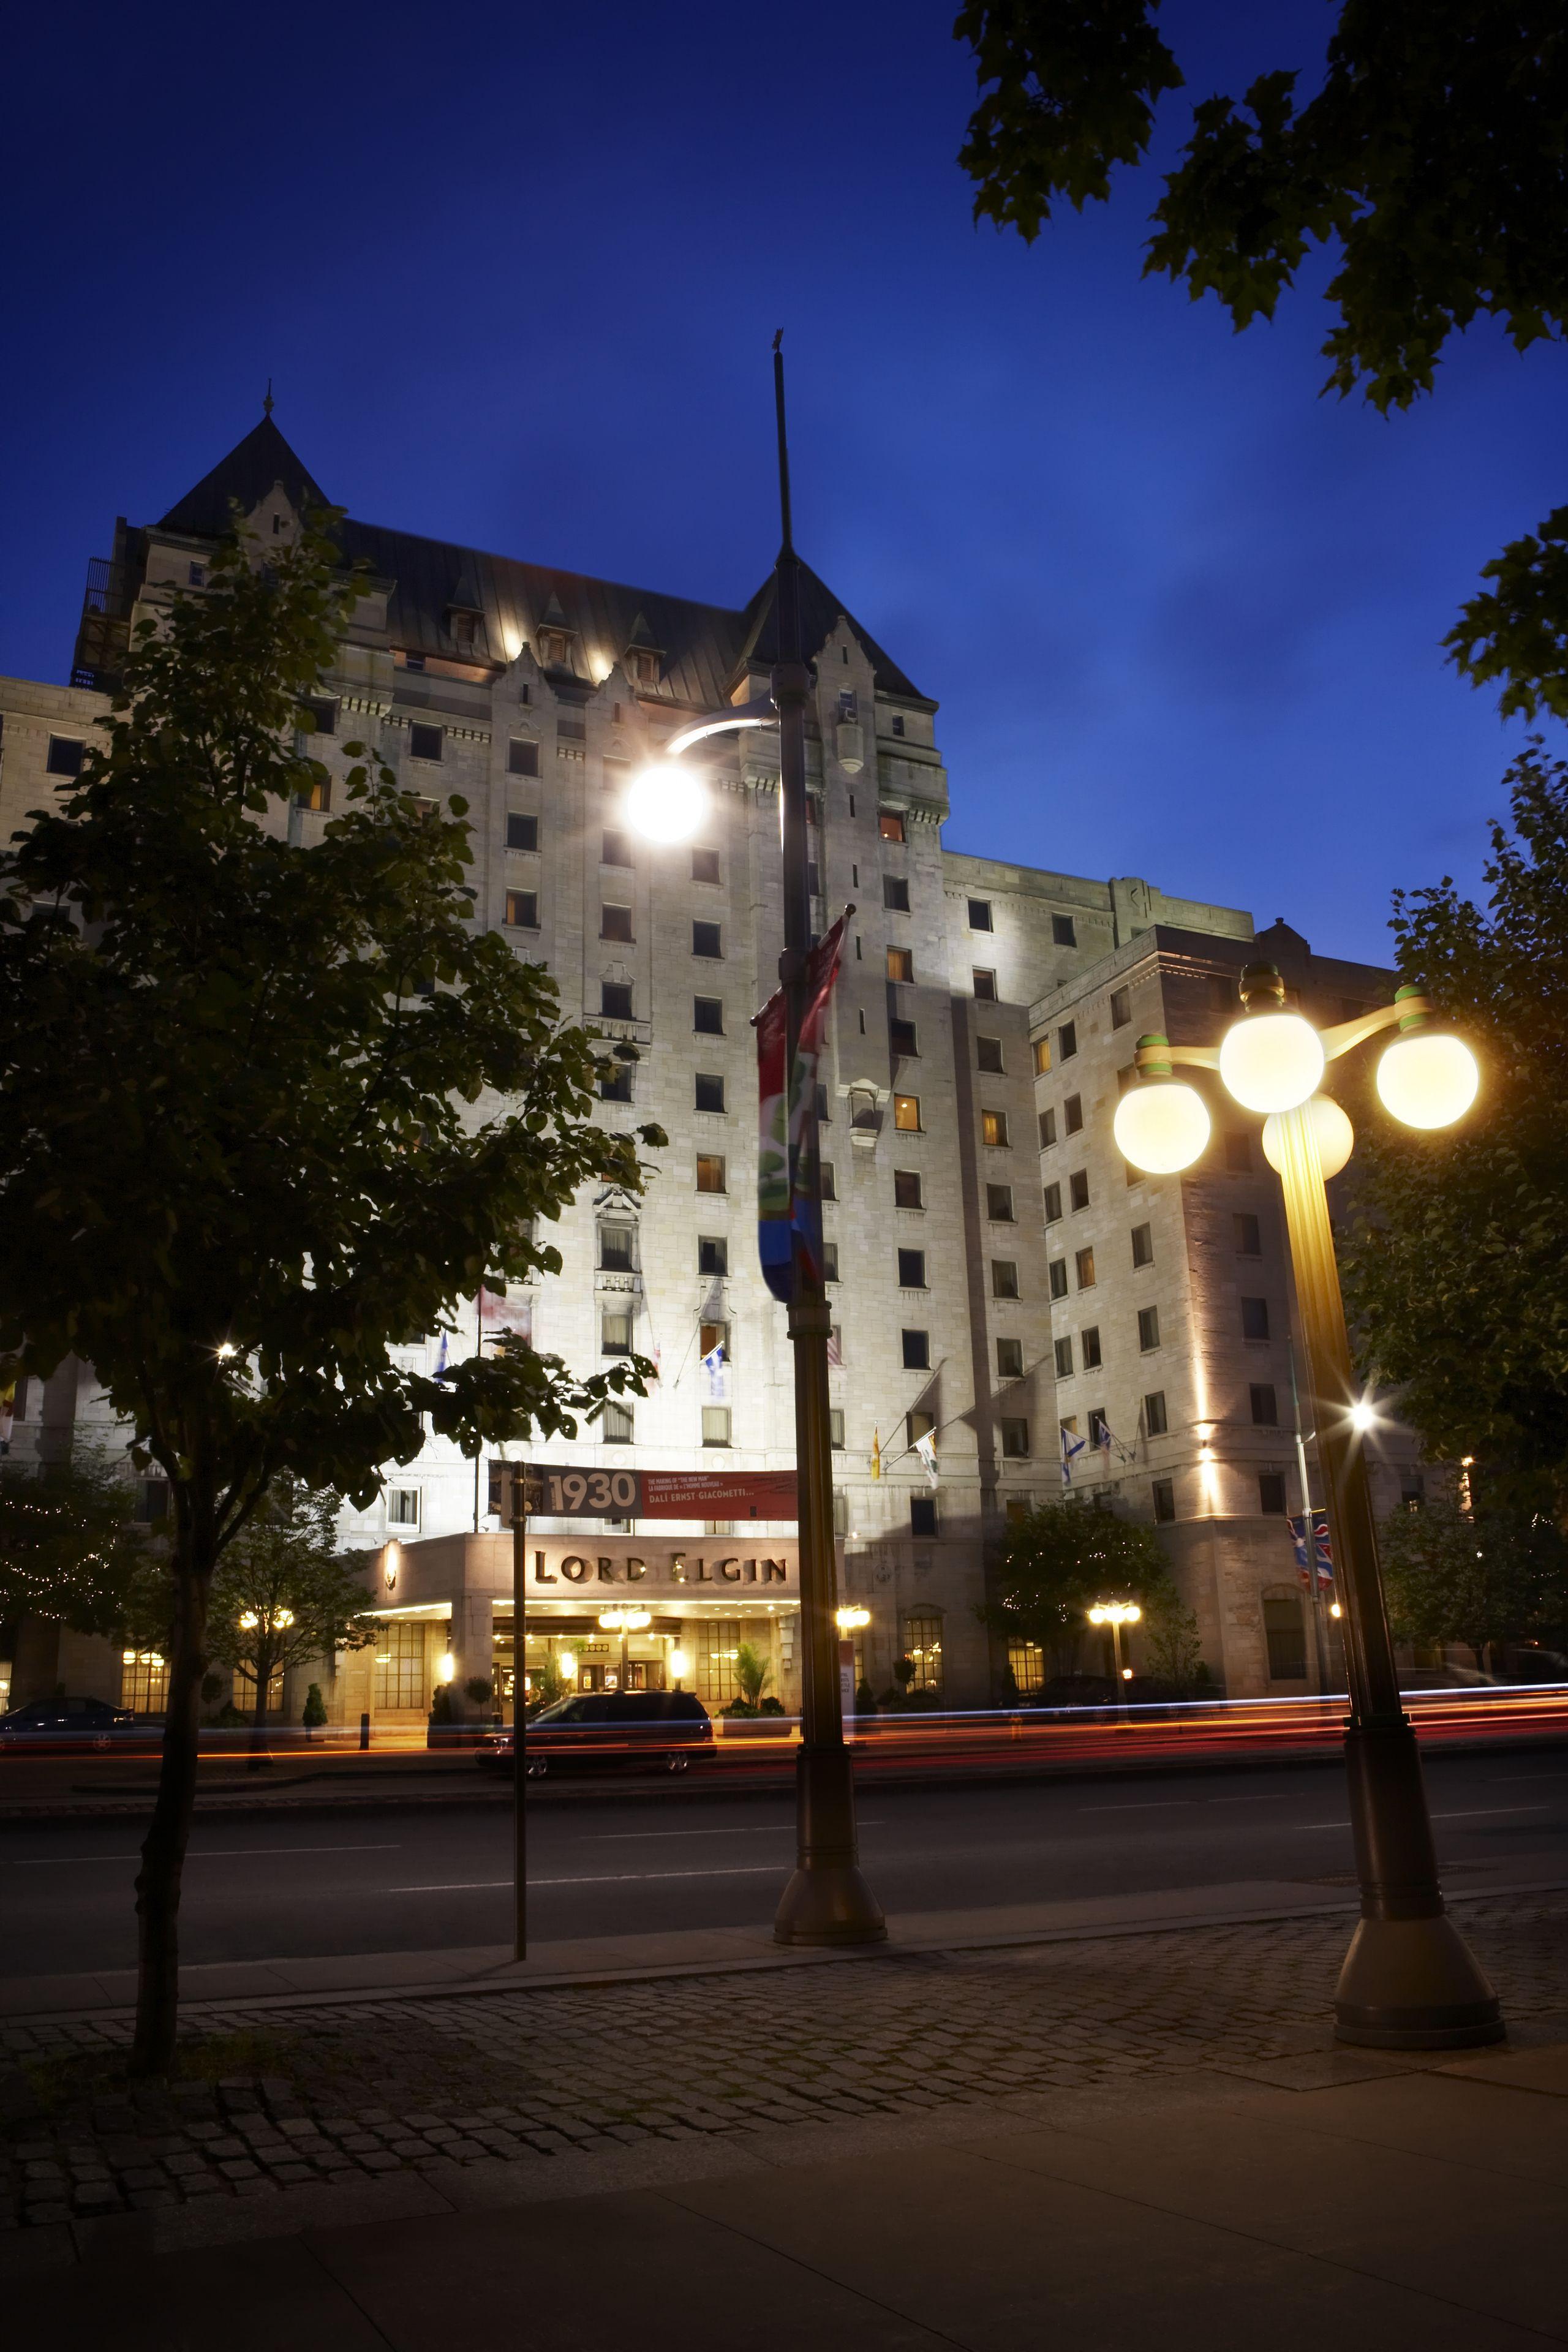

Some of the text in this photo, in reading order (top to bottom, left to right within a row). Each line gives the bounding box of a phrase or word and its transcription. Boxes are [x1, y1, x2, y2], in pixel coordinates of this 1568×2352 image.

[549, 1472, 636, 1510] 1930
[671, 1493, 695, 1502] ERNST
[535, 1551, 786, 1582] LORD ELGIN
